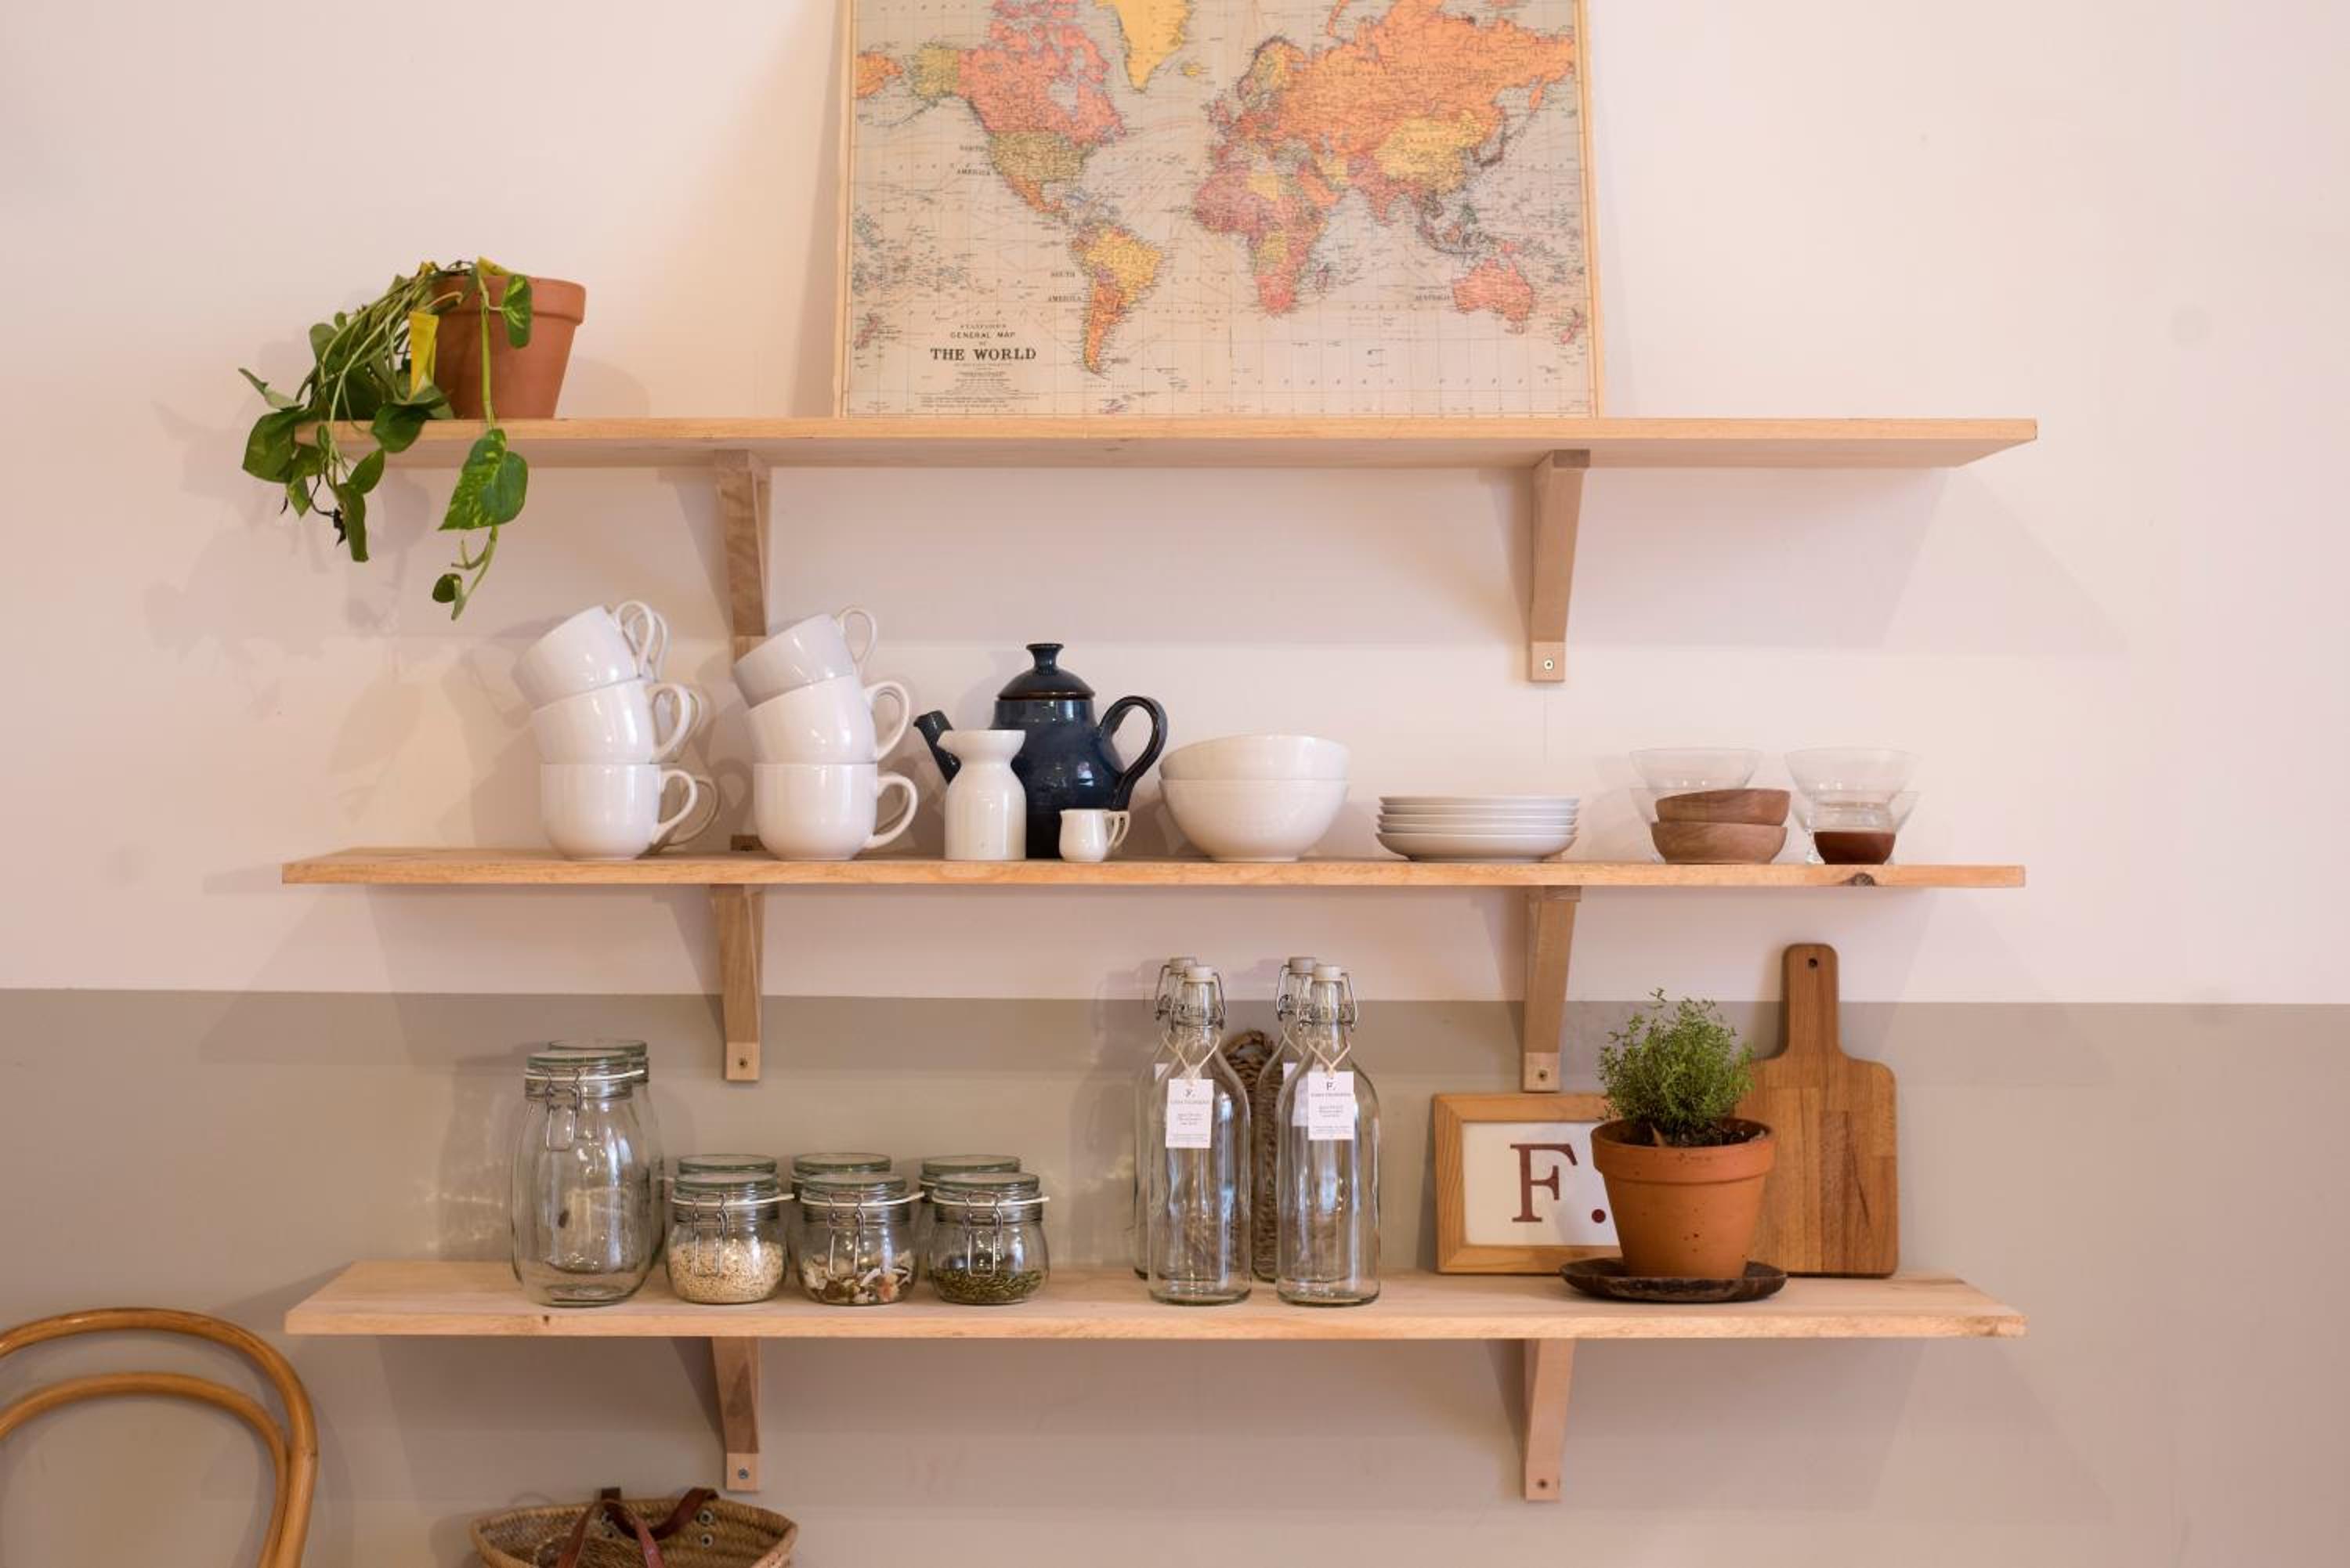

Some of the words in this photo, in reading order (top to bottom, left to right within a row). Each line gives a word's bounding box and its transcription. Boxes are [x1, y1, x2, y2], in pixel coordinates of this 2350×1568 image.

[930, 348, 964, 361] THE
[972, 347, 1037, 361] WORLD
[1510, 1143, 1607, 1224] F.
